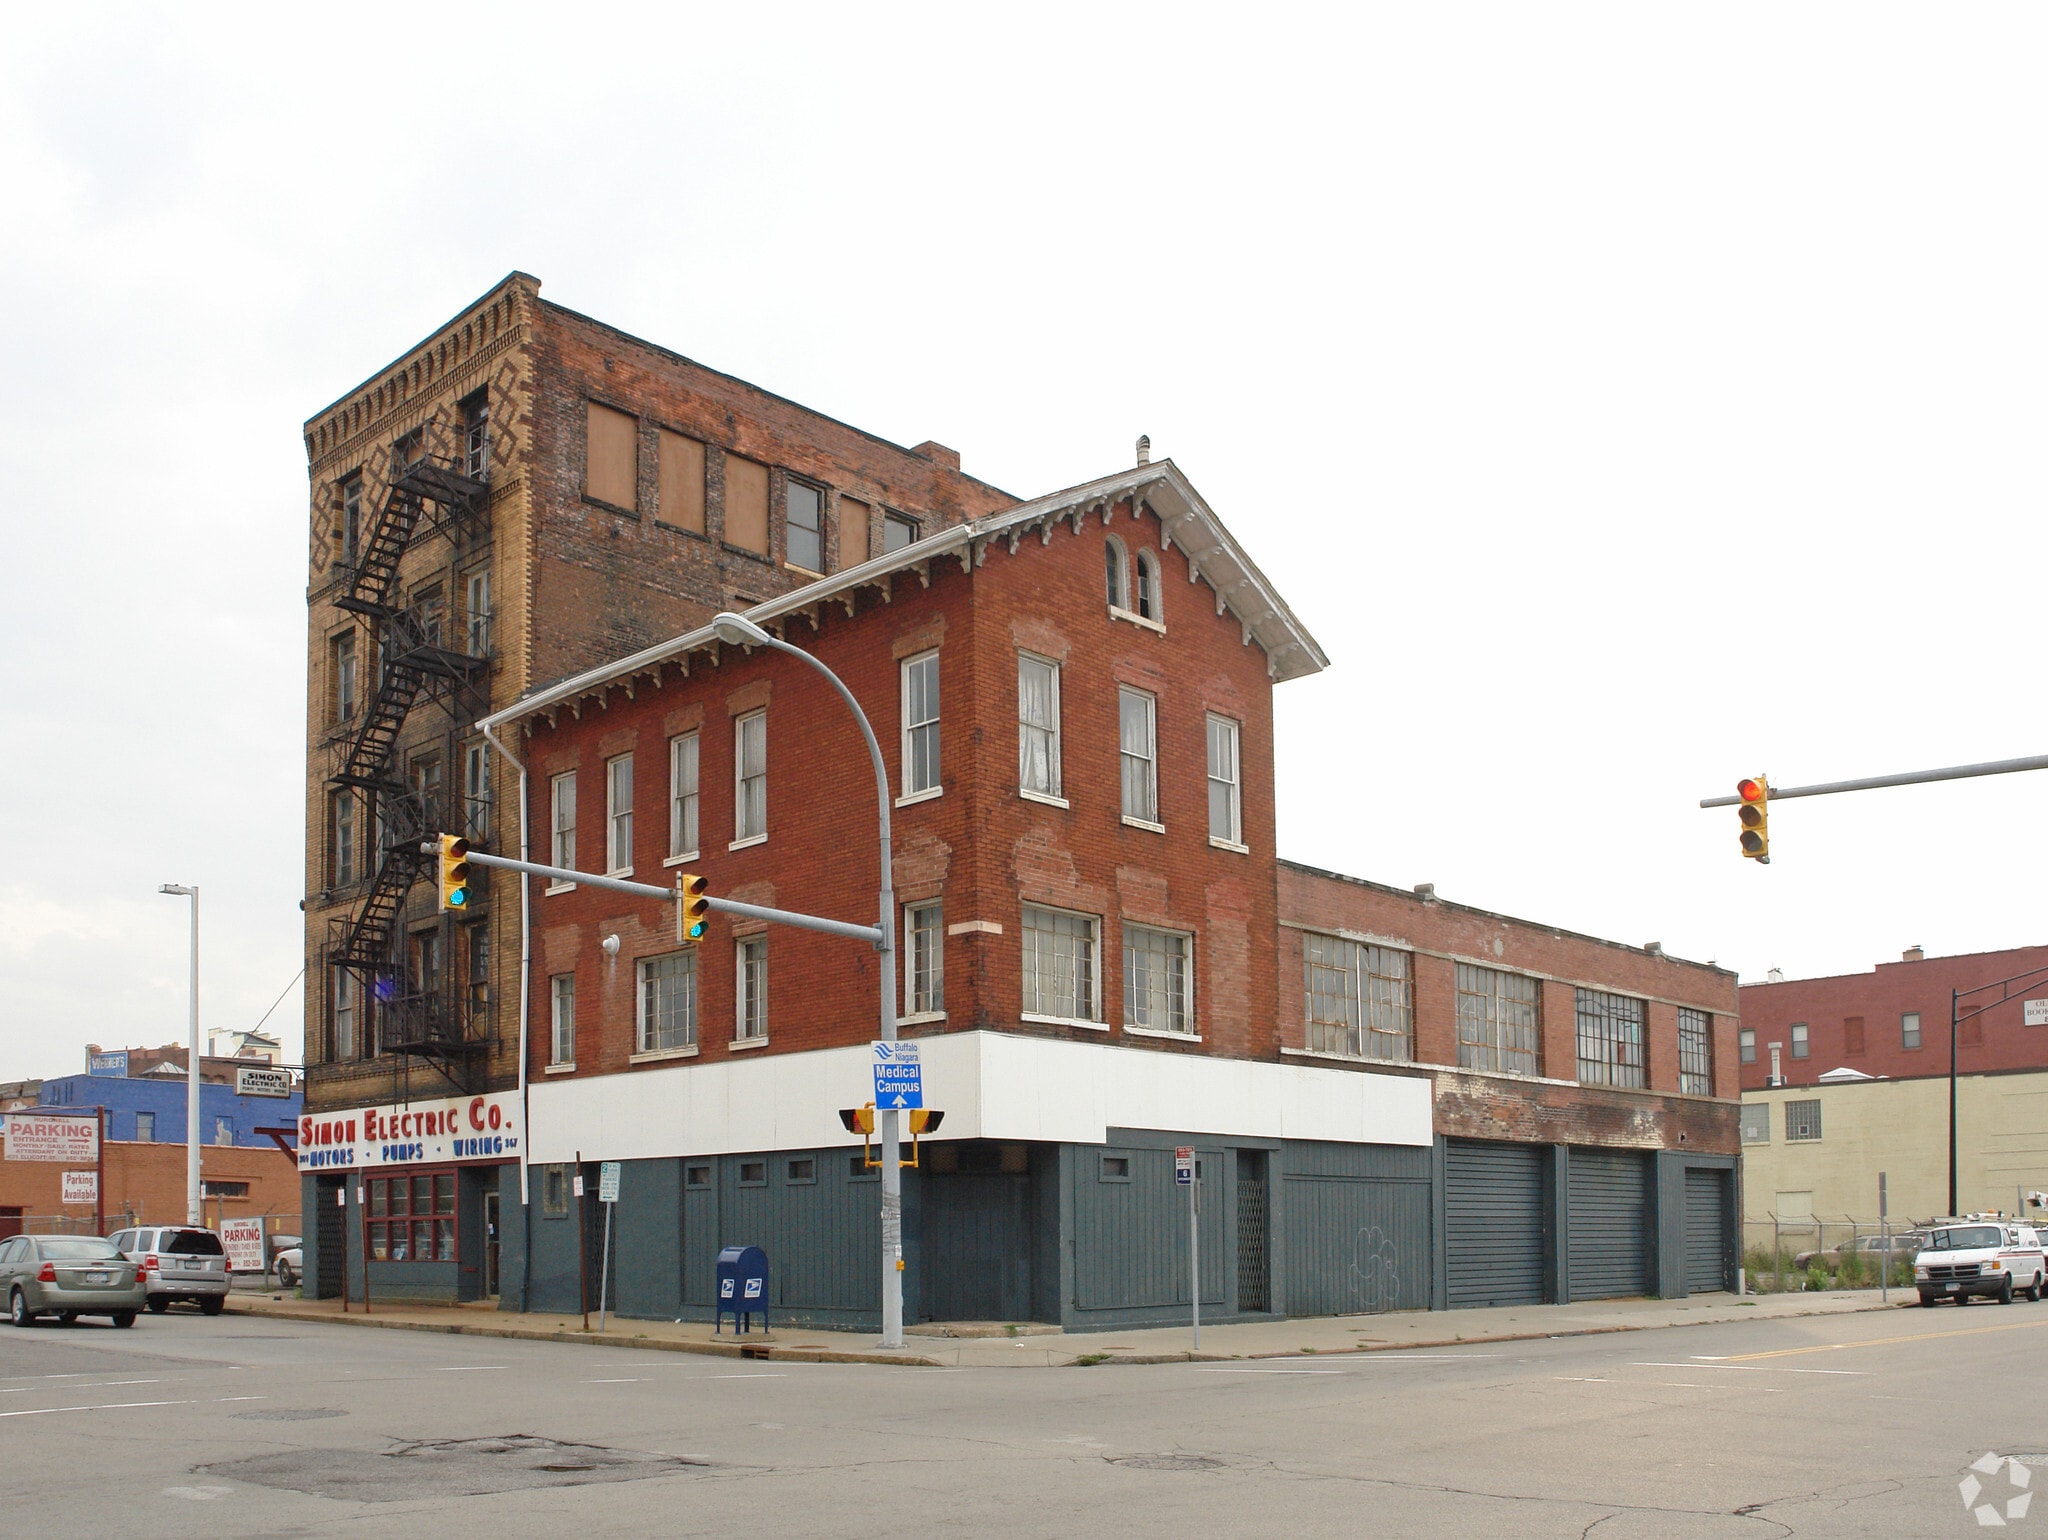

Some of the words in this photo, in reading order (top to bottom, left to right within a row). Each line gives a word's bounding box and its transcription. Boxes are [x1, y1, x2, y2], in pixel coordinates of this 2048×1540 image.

[894, 1042, 918, 1052] Buffalo
[895, 1053, 919, 1063] Niagara
[247, 1072, 282, 1082] SIMON
[876, 1065, 919, 1078] Medical
[242, 1078, 277, 1088] ELECTRIC
[876, 1079, 920, 1096] Campus
[10, 1123, 93, 1137] PARKING
[310, 1147, 355, 1167] MOTORS
[382, 1142, 424, 1162] PUMPS
[453, 1135, 503, 1157] WIRING
[66, 1173, 94, 1187] Parking
[63, 1188, 97, 1200] Available
[225, 1228, 260, 1241] PARKING
